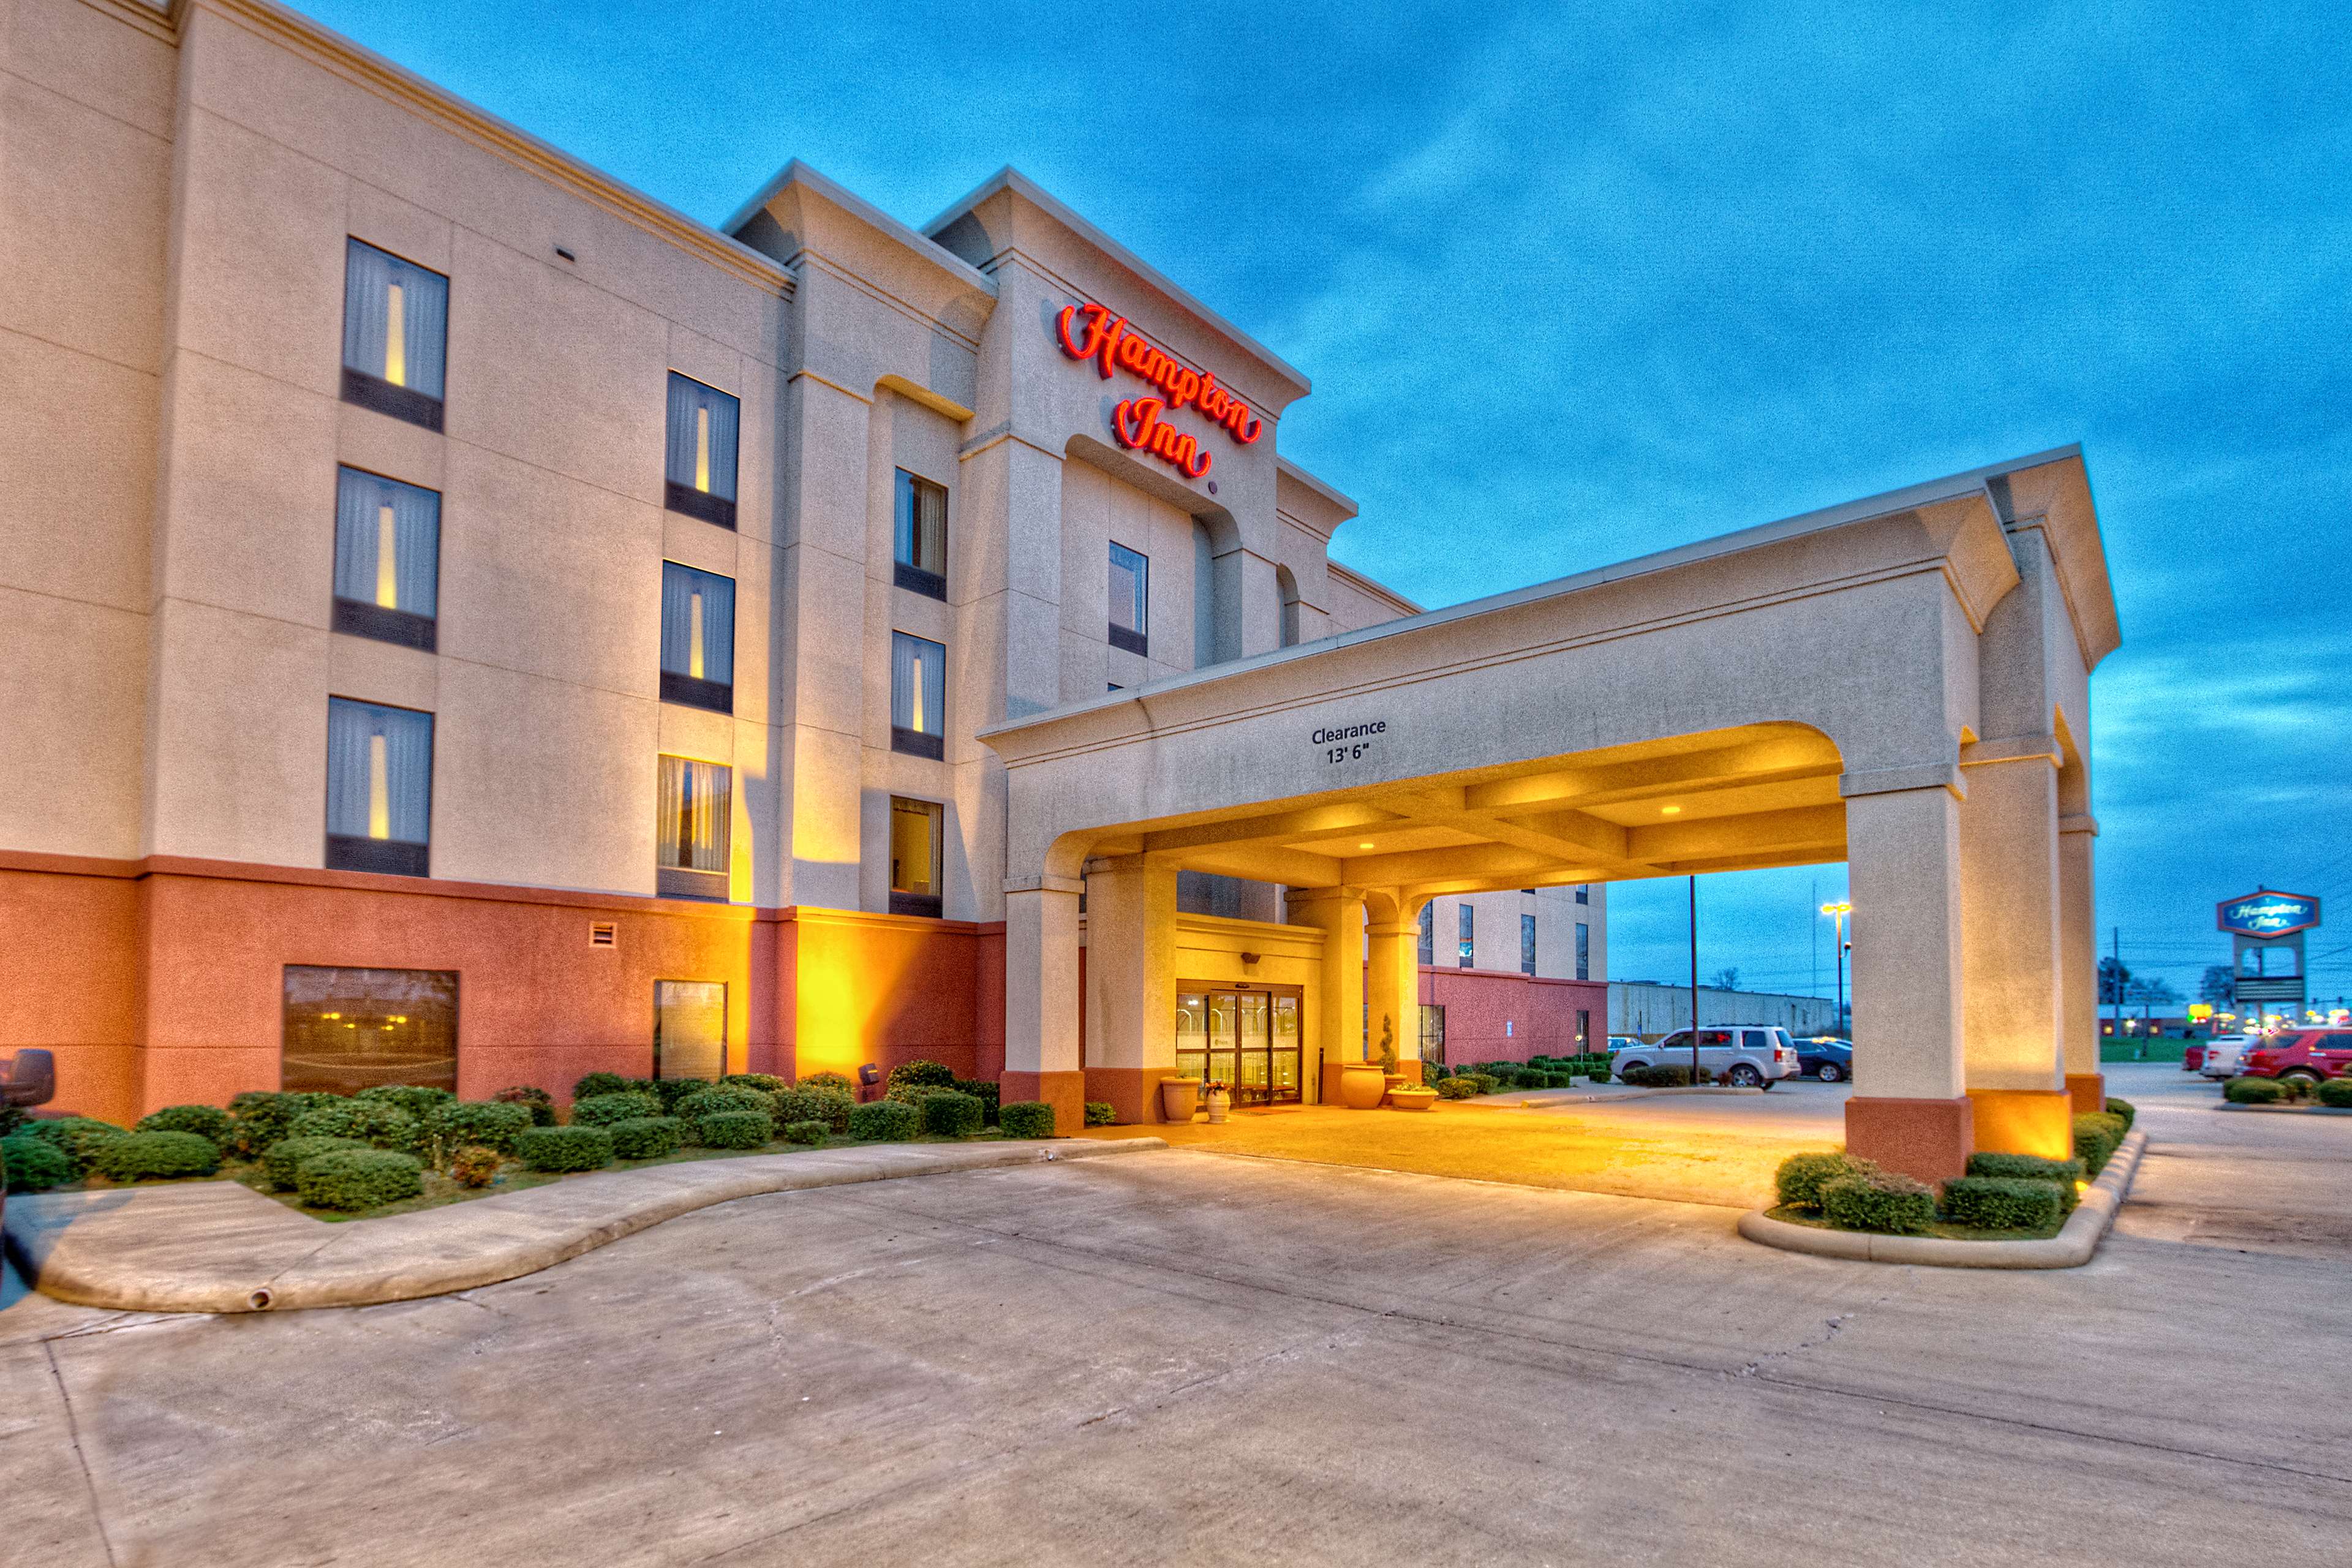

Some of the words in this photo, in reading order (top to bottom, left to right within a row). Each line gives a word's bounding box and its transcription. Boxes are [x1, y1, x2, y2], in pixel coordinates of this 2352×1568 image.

[1055, 303, 1262, 444] Hampton
[1110, 397, 1212, 478] Inn
[1312, 721, 1386, 744] Clearance
[1327, 747, 1348, 764] 13'
[2230, 903, 2308, 919] Hampton
